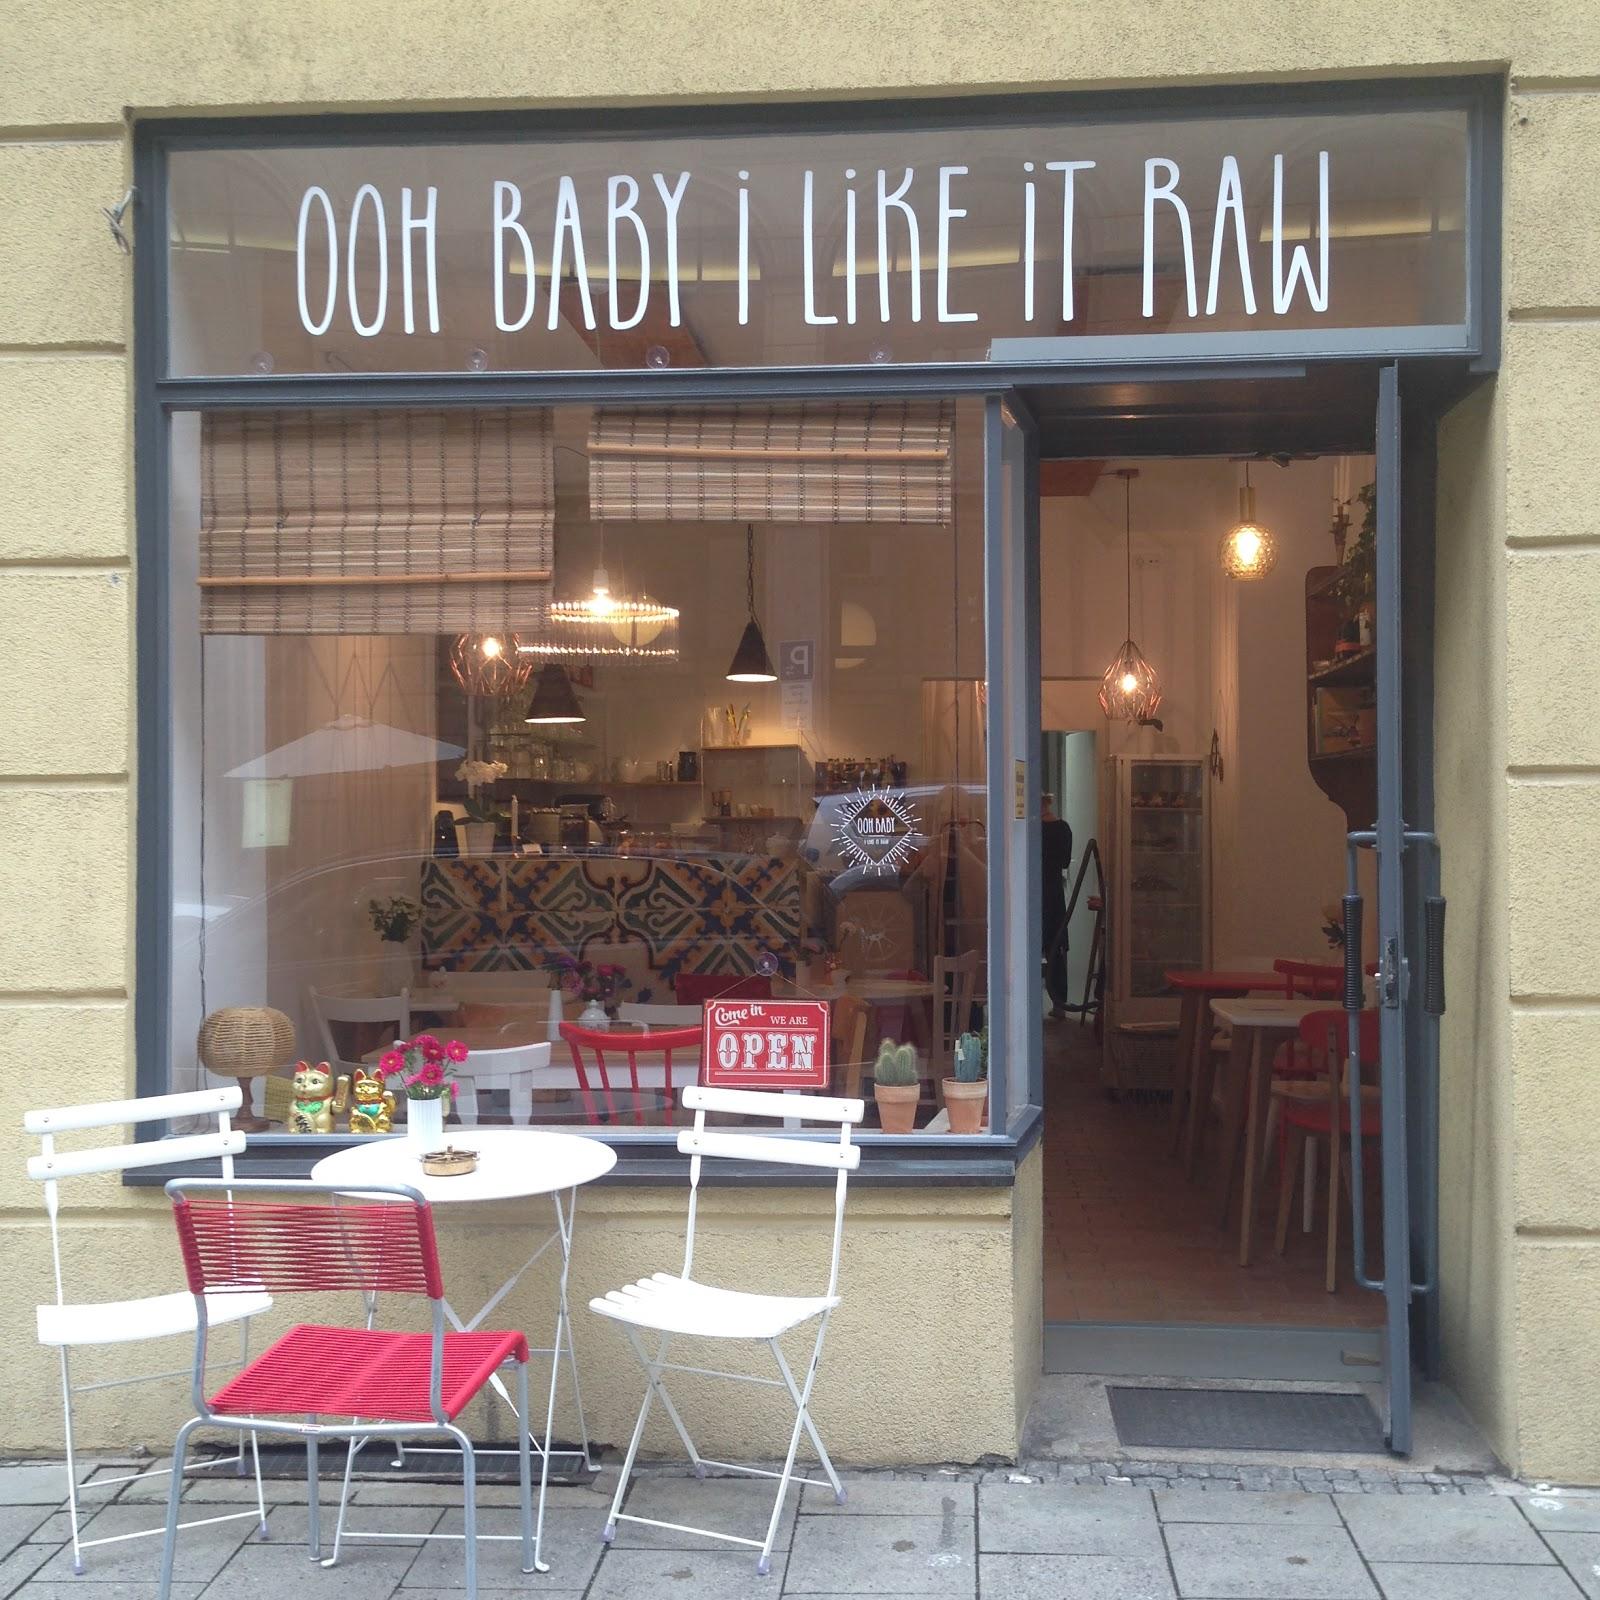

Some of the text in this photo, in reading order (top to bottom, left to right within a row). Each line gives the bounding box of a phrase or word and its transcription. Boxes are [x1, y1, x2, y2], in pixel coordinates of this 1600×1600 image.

[297, 183, 440, 337] OOH
[493, 171, 691, 332] BABY
[1142, 150, 1329, 318] RAW
[857, 816, 895, 834] OOH BABY
[715, 1003, 766, 1026] Come in
[770, 1015, 808, 1025] WE ARE
[717, 1031, 817, 1071] OPEN
